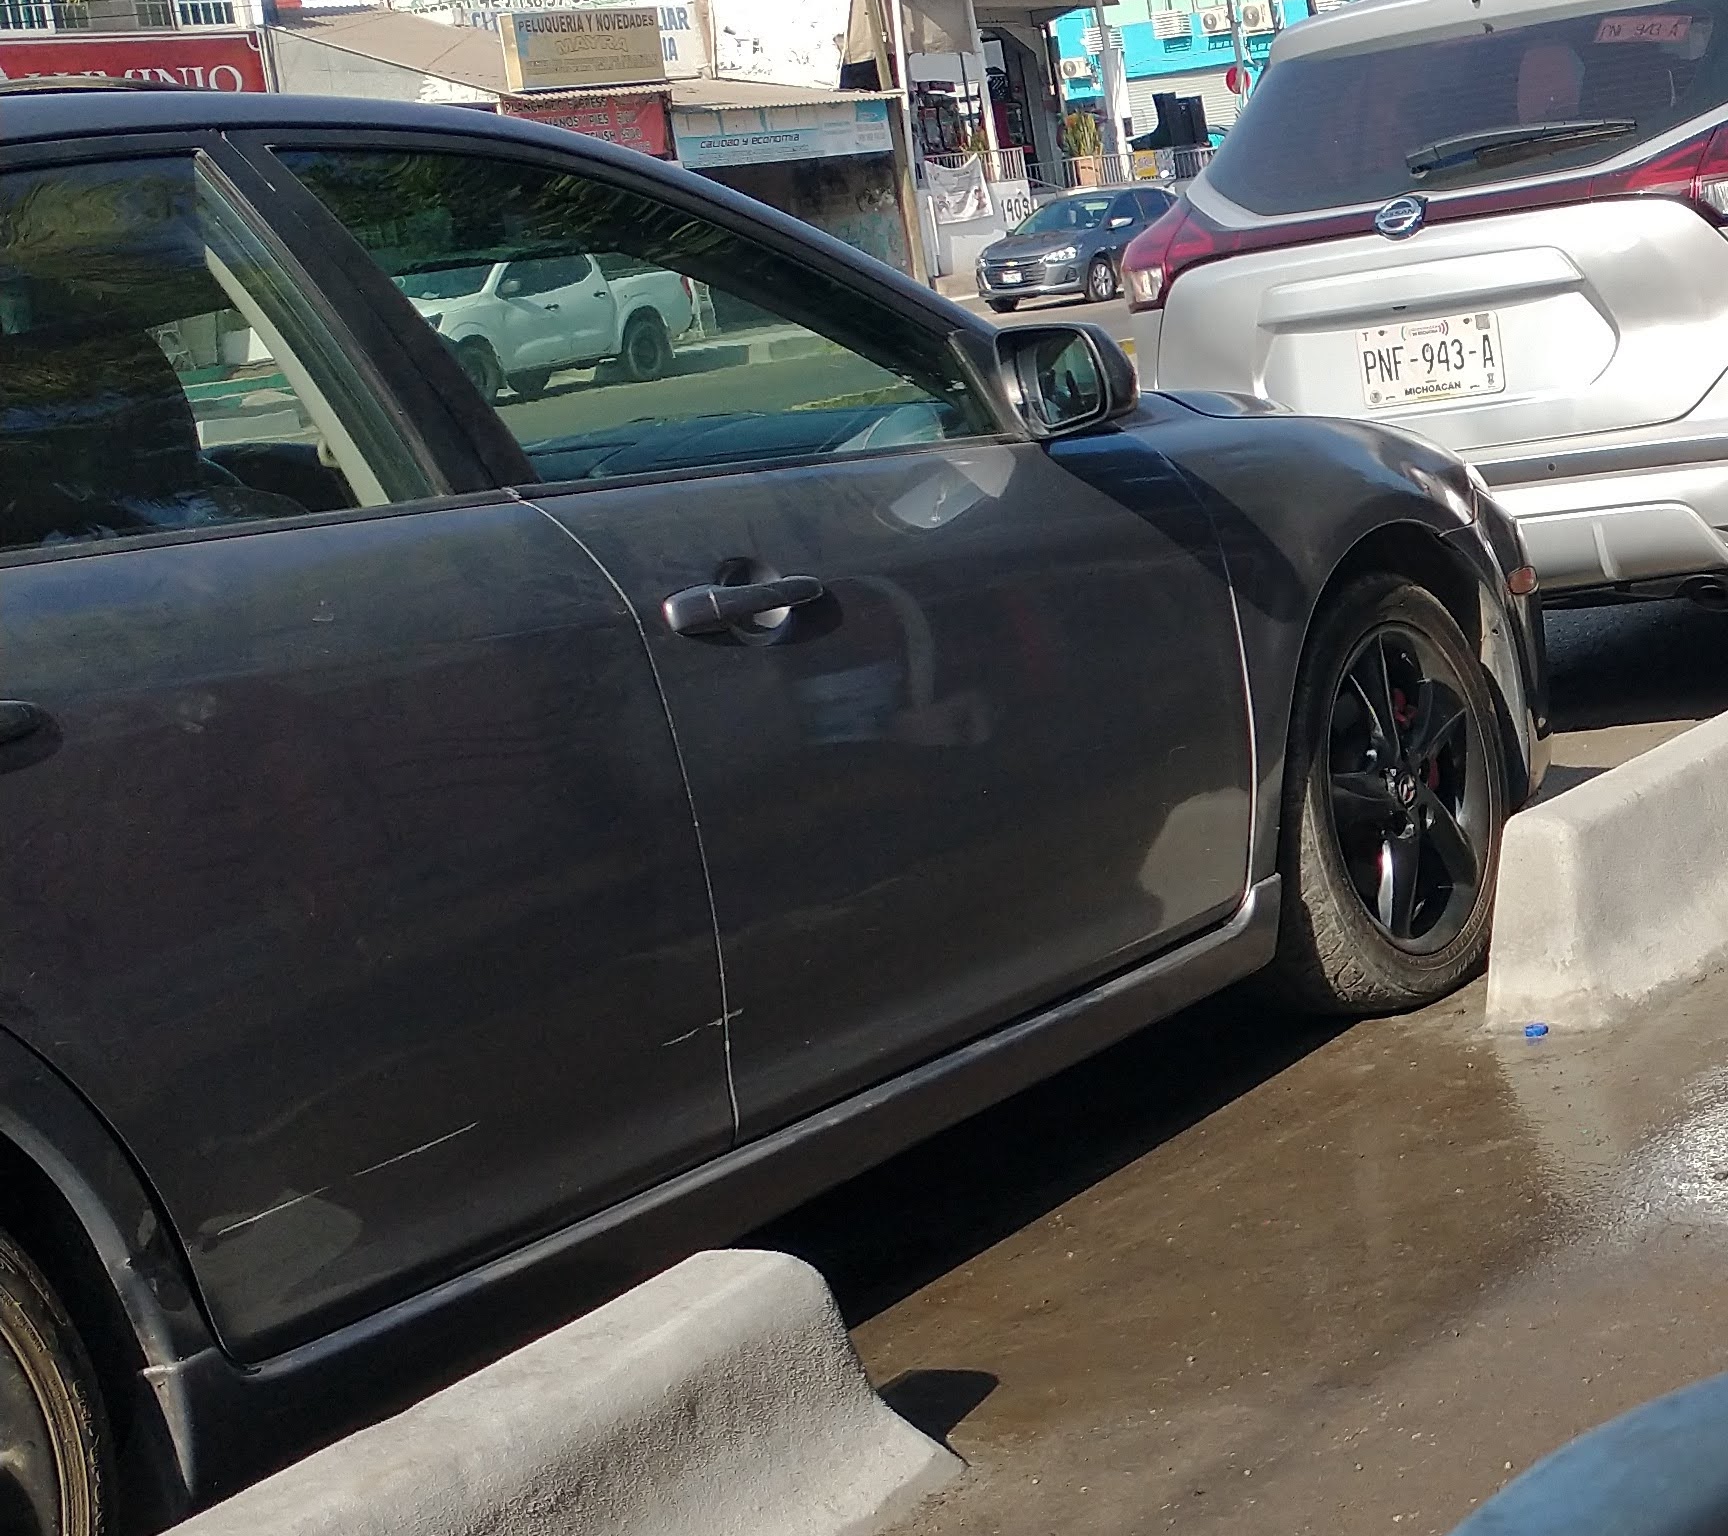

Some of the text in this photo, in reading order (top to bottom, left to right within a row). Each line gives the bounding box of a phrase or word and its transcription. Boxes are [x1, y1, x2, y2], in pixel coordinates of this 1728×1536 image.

[517, 14, 585, 34] PELUQUERIA
[586, 14, 594, 33] Y
[595, 13, 655, 33] NOVEDADES
[554, 35, 629, 56] MAYRA
[1362, 333, 1495, 385] PNF-943-A
